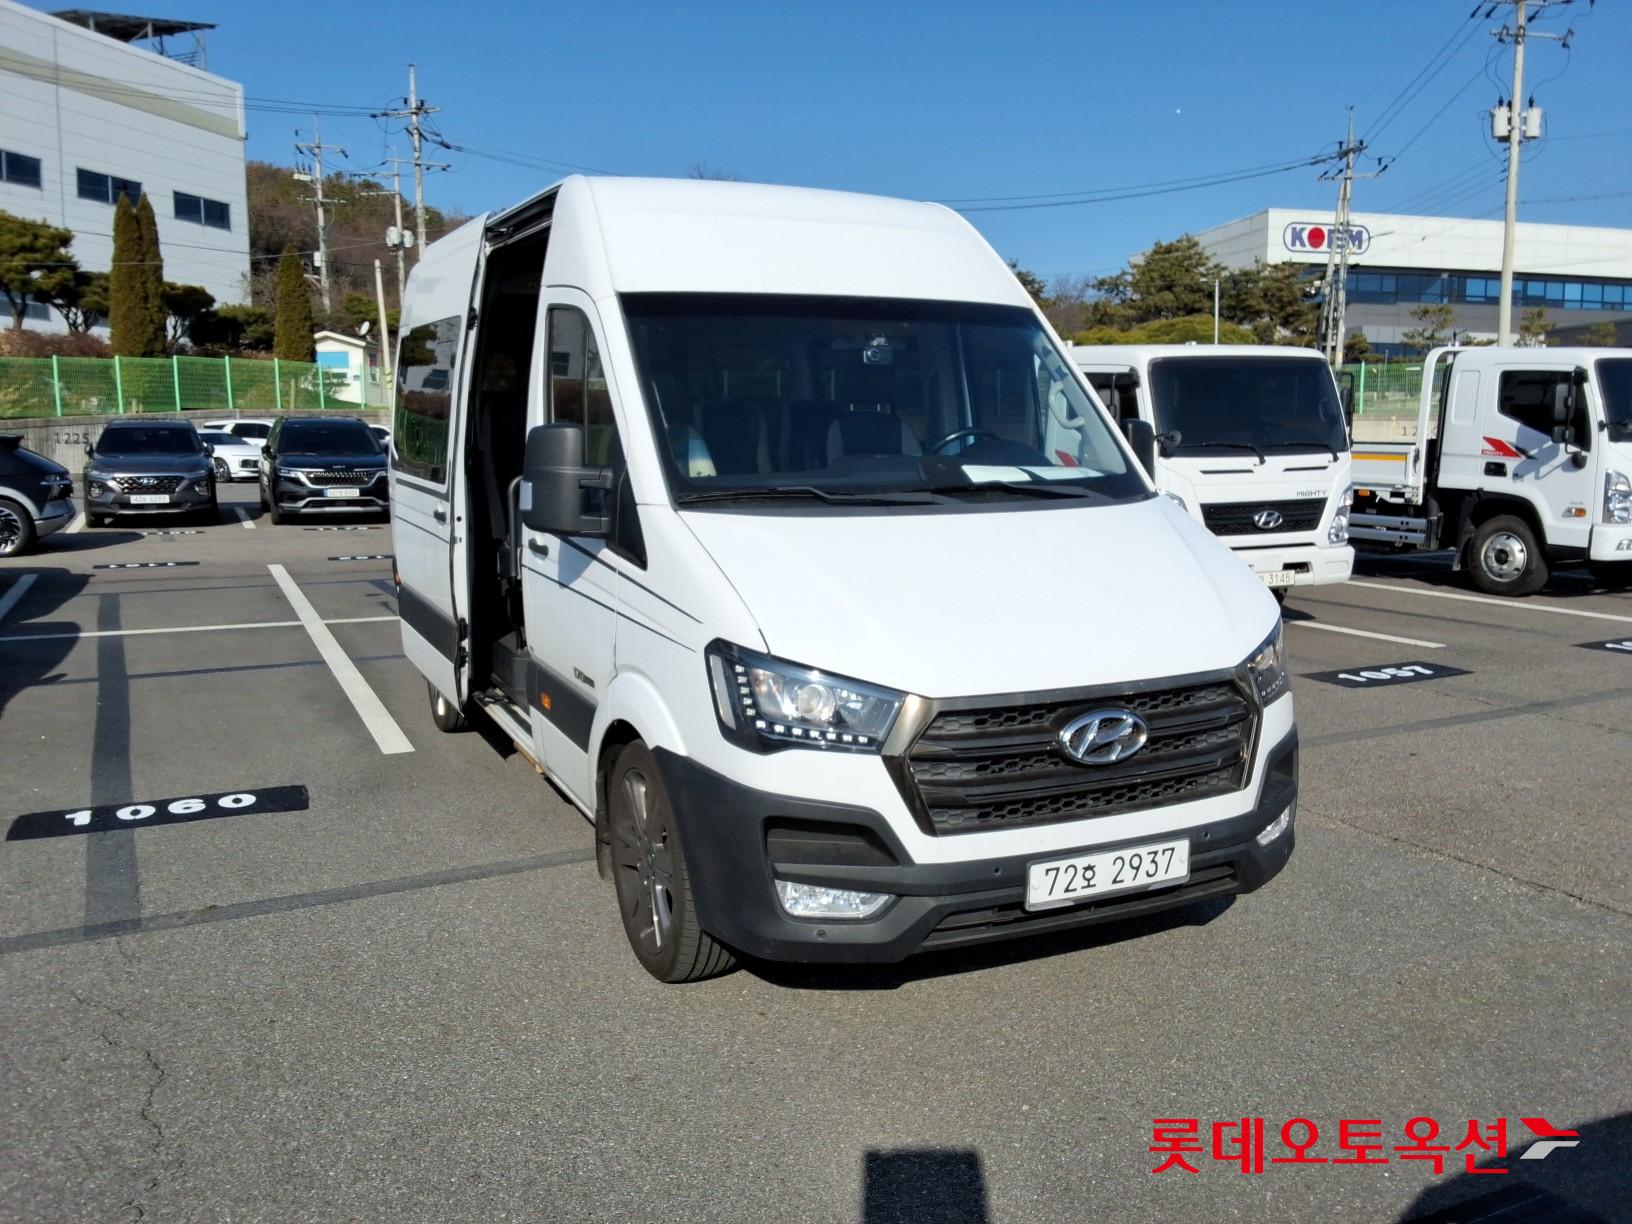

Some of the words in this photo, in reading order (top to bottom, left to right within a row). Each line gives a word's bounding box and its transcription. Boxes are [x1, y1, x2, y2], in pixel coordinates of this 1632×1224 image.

[54, 431, 90, 445] 1225
[1296, 489, 1327, 498] MIGHTY
[64, 793, 257, 827] 1060
[1045, 864, 1097, 897] 72호
[1111, 847, 1176, 885] 2937
